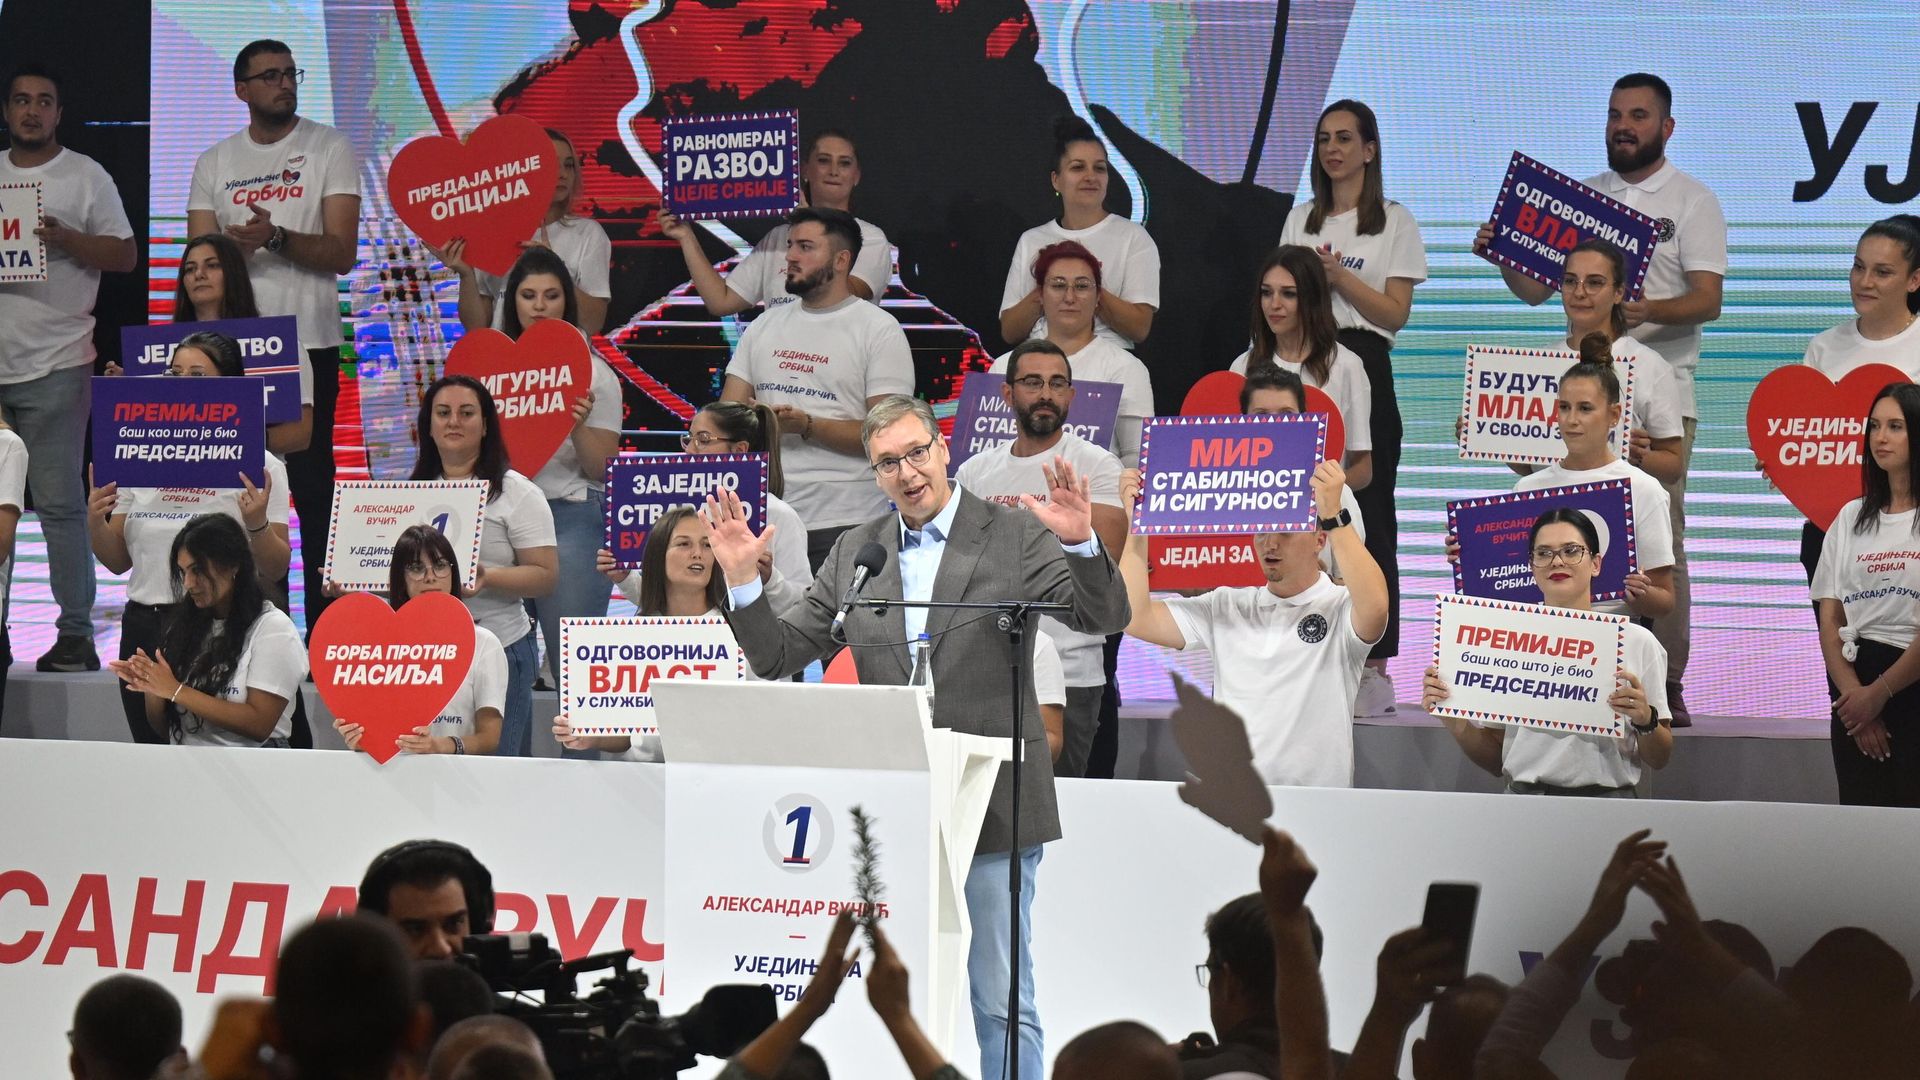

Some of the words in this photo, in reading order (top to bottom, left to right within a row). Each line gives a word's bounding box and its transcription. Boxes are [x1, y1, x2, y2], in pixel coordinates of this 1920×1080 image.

[673, 130, 787, 151] РАВНОМЕРАН
[676, 150, 784, 181] РАЗВОЈ
[408, 169, 492, 205] ПРЕДАЈА
[495, 155, 541, 180] НИЈЕ
[722, 180, 787, 199] СРБИЈЕ
[233, 184, 304, 207] Србија
[431, 179, 530, 221] ОПЦИЈА
[674, 183, 718, 203] ЦЕЛЕ
[1515, 182, 1639, 255] ОДГОВОРНИЈА
[1515, 203, 1595, 251] ВЛА
[1500, 224, 1511, 236] У
[138, 336, 283, 365] ЈЕТВО
[772, 350, 829, 364] УЈЕДИЊЕНА
[779, 361, 814, 373] СРБИЈА
[480, 365, 573, 396] ИГУРНА
[1479, 371, 1558, 394] БУДУЋ
[806, 388, 837, 400] ВУЧИЋ
[113, 403, 240, 425] ПРЕМИЈЕР,
[494, 391, 565, 419] РБИЈА
[119, 426, 145, 438] баш
[148, 428, 170, 438] као
[173, 428, 197, 438] што
[199, 426, 212, 440] је
[214, 426, 237, 438] био
[1476, 421, 1486, 434] У
[1489, 422, 1550, 439] СВОЈОЈ
[115, 444, 243, 462] ПРЕДСЕДНИК!
[1189, 437, 1274, 468] МИР
[1779, 441, 1863, 466] СРБИ
[632, 472, 739, 497] ЗАЈЕДНО
[1152, 469, 1305, 490] СТАБИЛНОСТ
[162, 494, 200, 503] СРБИЈА
[353, 504, 415, 514] АЛЕКСАНДАР
[1149, 494, 1166, 511] И
[1169, 491, 1303, 512] СИГУРНОСТ
[366, 517, 397, 525] ВУЧИЋ
[1475, 516, 1538, 533] АЛЕКСАНД
[350, 546, 394, 556] УЈЕДИЊЕ
[1160, 546, 1225, 568] ЈЕДАН
[1229, 545, 1254, 563] ЗА
[1480, 563, 1533, 578] УЈЕДИЊЕ
[1867, 562, 1905, 573] СРБИЈА
[1494, 576, 1537, 590] СРБИЈА
[325, 645, 383, 661] БОРБА
[386, 644, 457, 660] ПРОТИВ
[576, 644, 729, 664] ОДГОВОРНИЈА
[1456, 624, 1597, 666] ПРЕМИЈЕР,
[332, 664, 444, 685] НАСИЉА
[1461, 651, 1490, 666] баш
[1493, 657, 1518, 669] као
[1522, 662, 1549, 673] што
[1550, 664, 1565, 677] је
[1567, 664, 1593, 679] био
[1454, 670, 1598, 702] ПРЕДСЕДНИК!
[577, 696, 586, 708] У
[589, 696, 654, 708] СЛУЖБИ
[783, 806, 812, 867] 1
[703, 895, 825, 917] АЛЕКСАНДАР
[734, 955, 862, 978] УЈЕДИЊА
